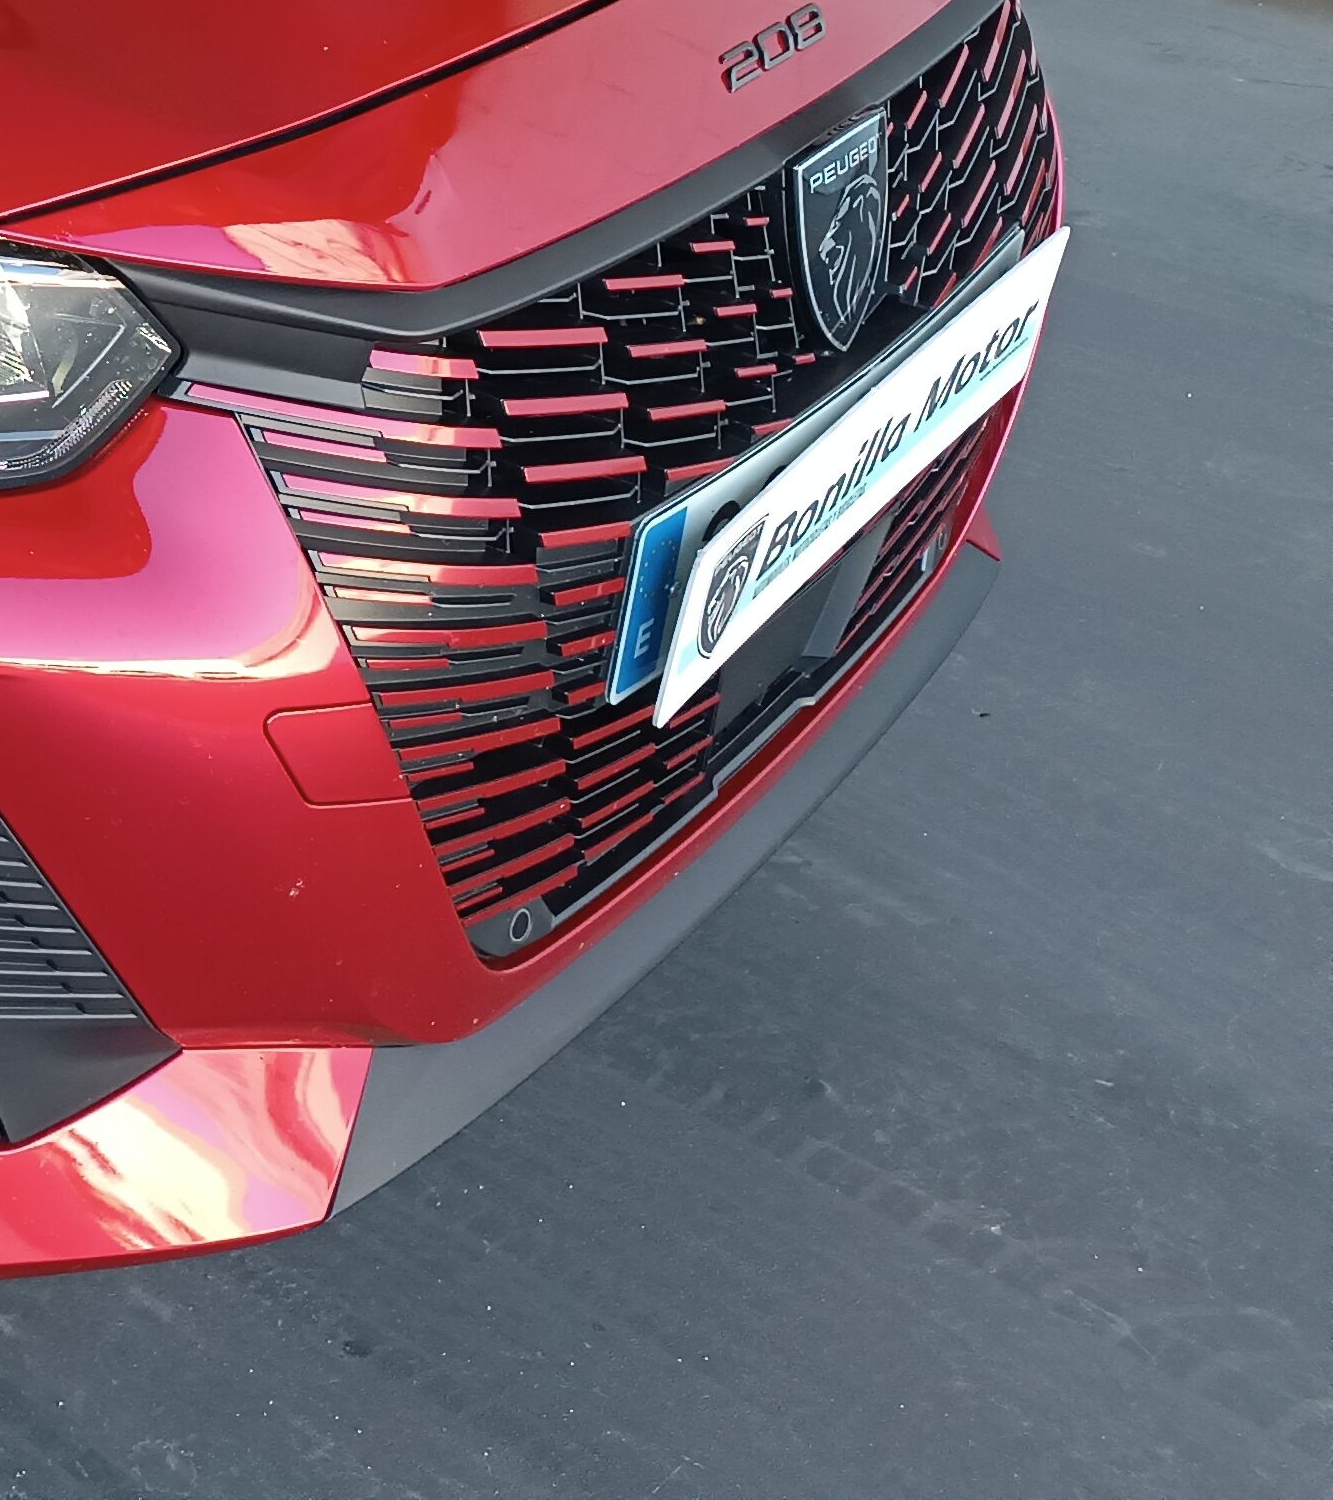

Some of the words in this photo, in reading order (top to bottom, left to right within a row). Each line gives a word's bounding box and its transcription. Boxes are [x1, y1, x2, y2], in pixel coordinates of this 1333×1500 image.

[719, 2, 827, 93] 208
[756, 412, 912, 581] Bonilla
[913, 298, 1040, 434] Motor
[633, 617, 654, 659] E
